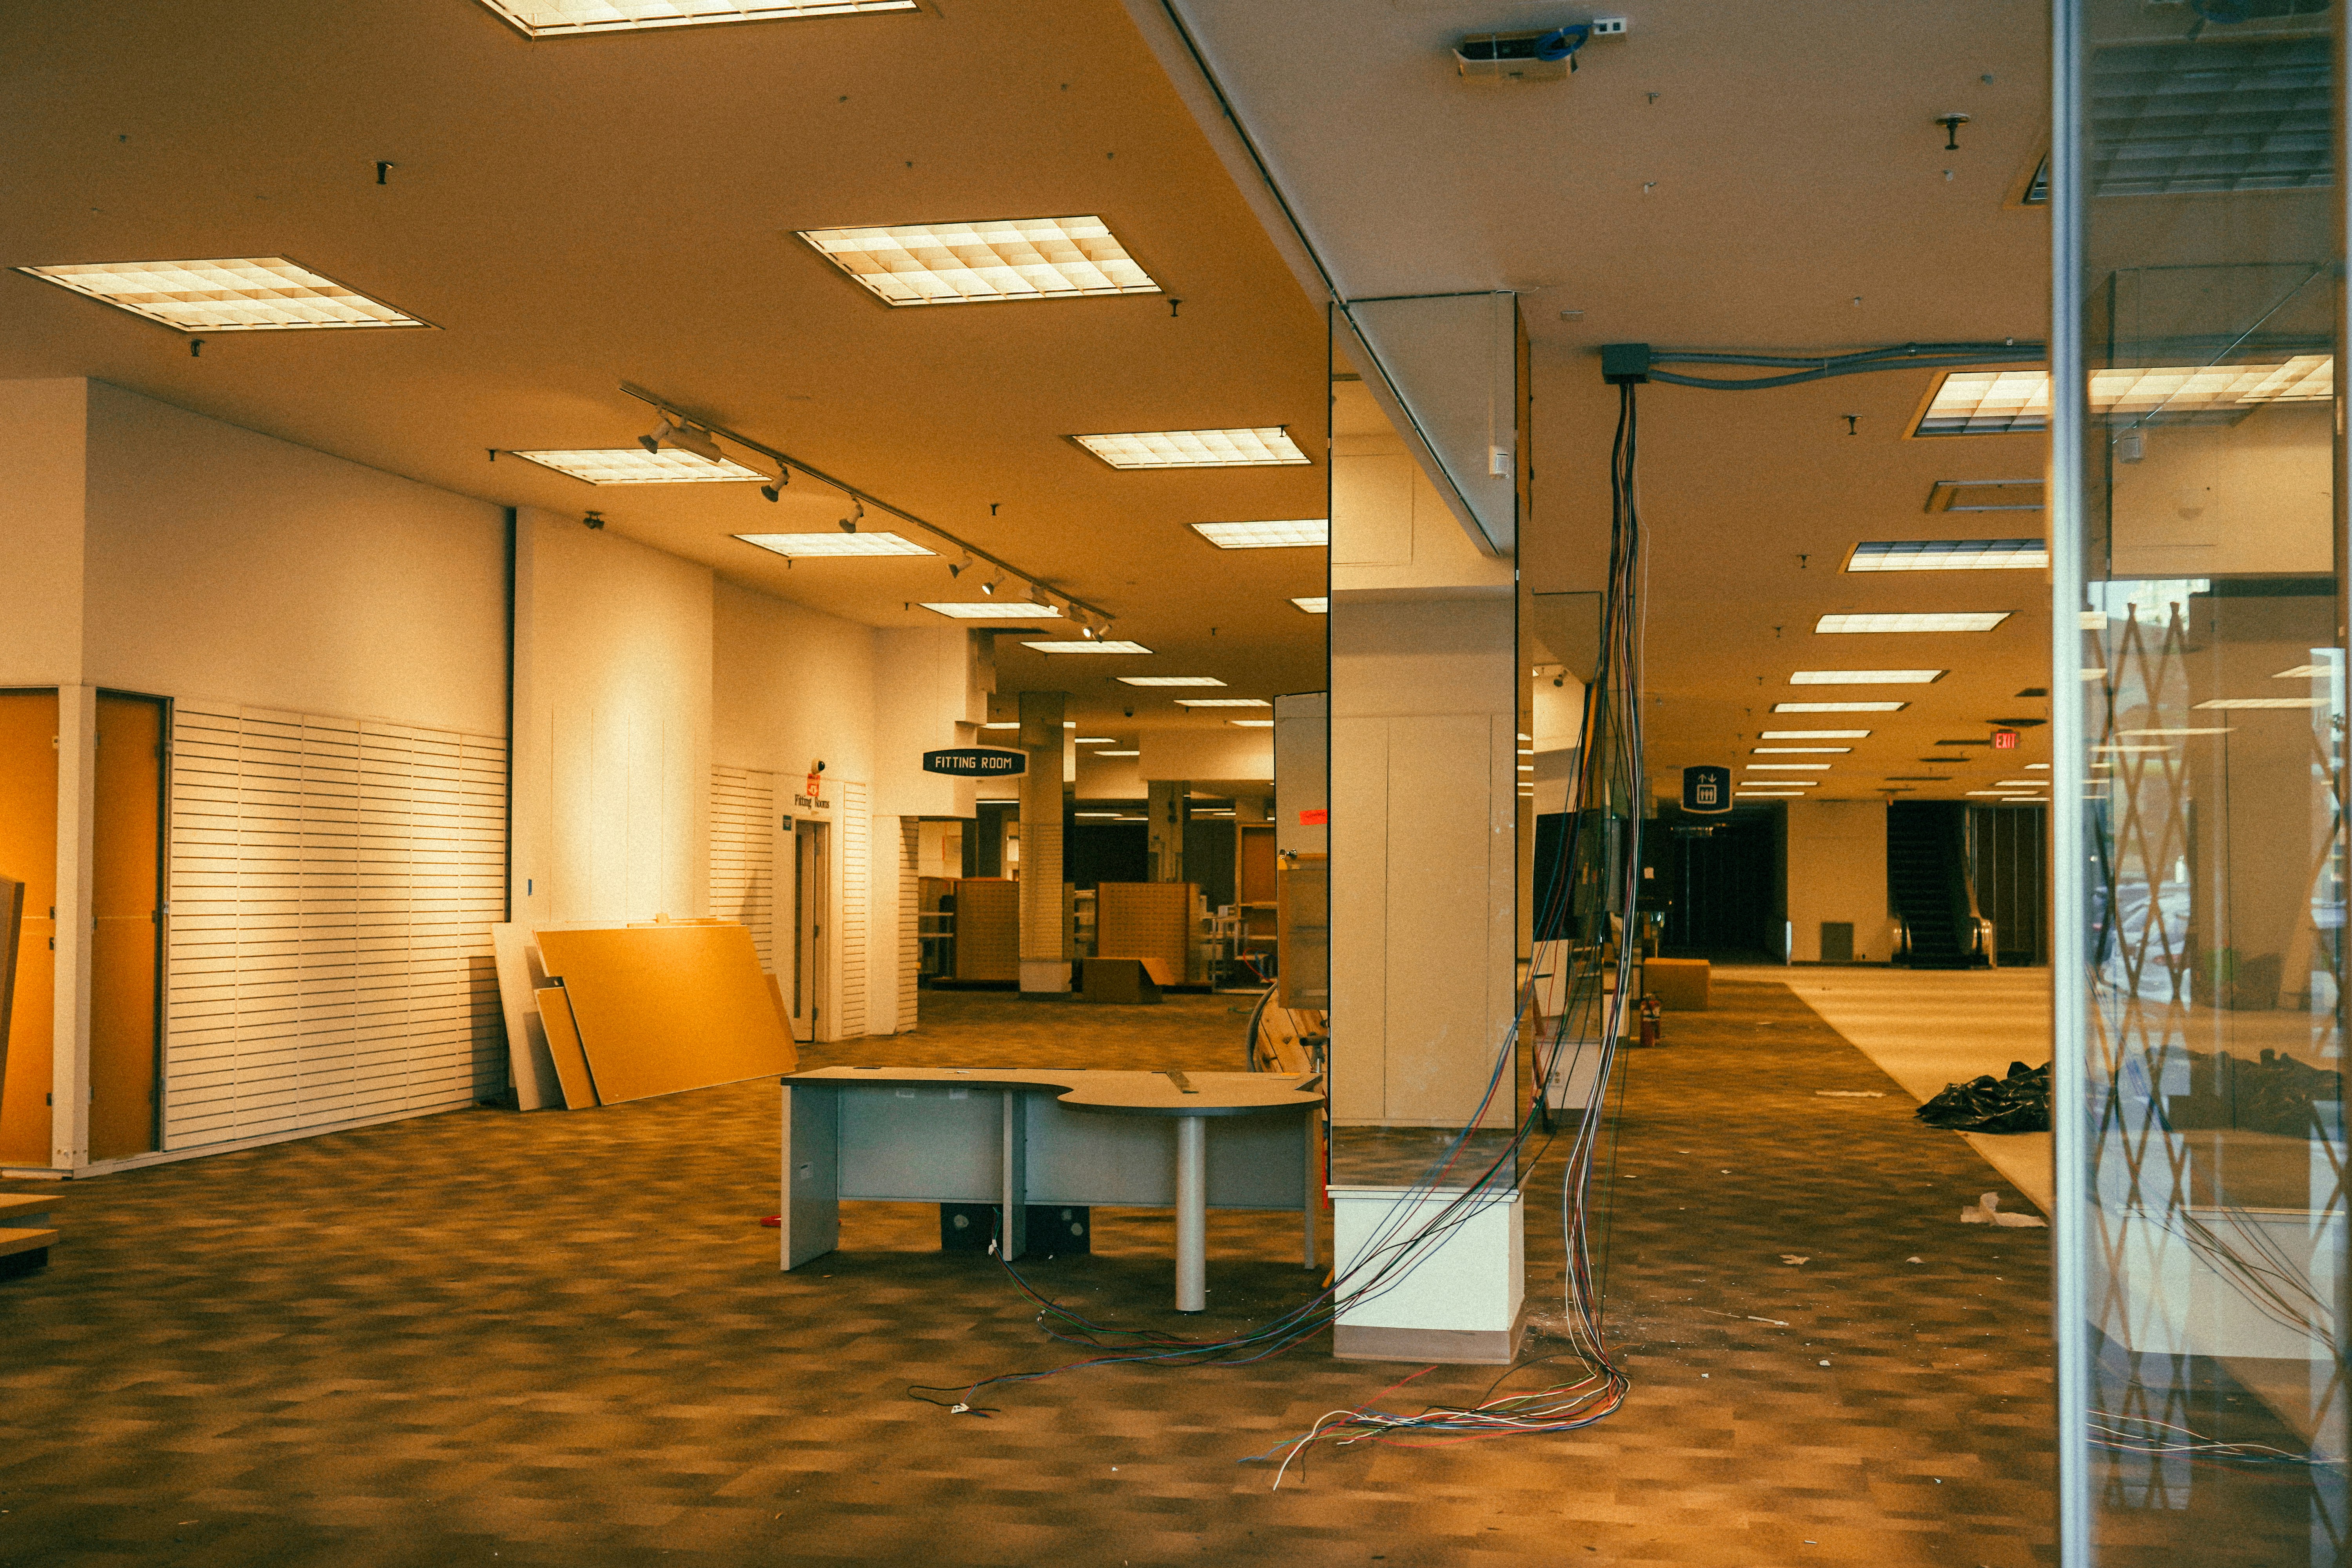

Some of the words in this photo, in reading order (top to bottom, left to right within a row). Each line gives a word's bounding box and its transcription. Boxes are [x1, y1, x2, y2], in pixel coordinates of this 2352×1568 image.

[1996, 733, 2016, 749] EXIT
[935, 756, 976, 768] FITTING
[982, 757, 1012, 769] ROOM
[795, 794, 811, 809] Fitting
[815, 797, 829, 809] Rooms
